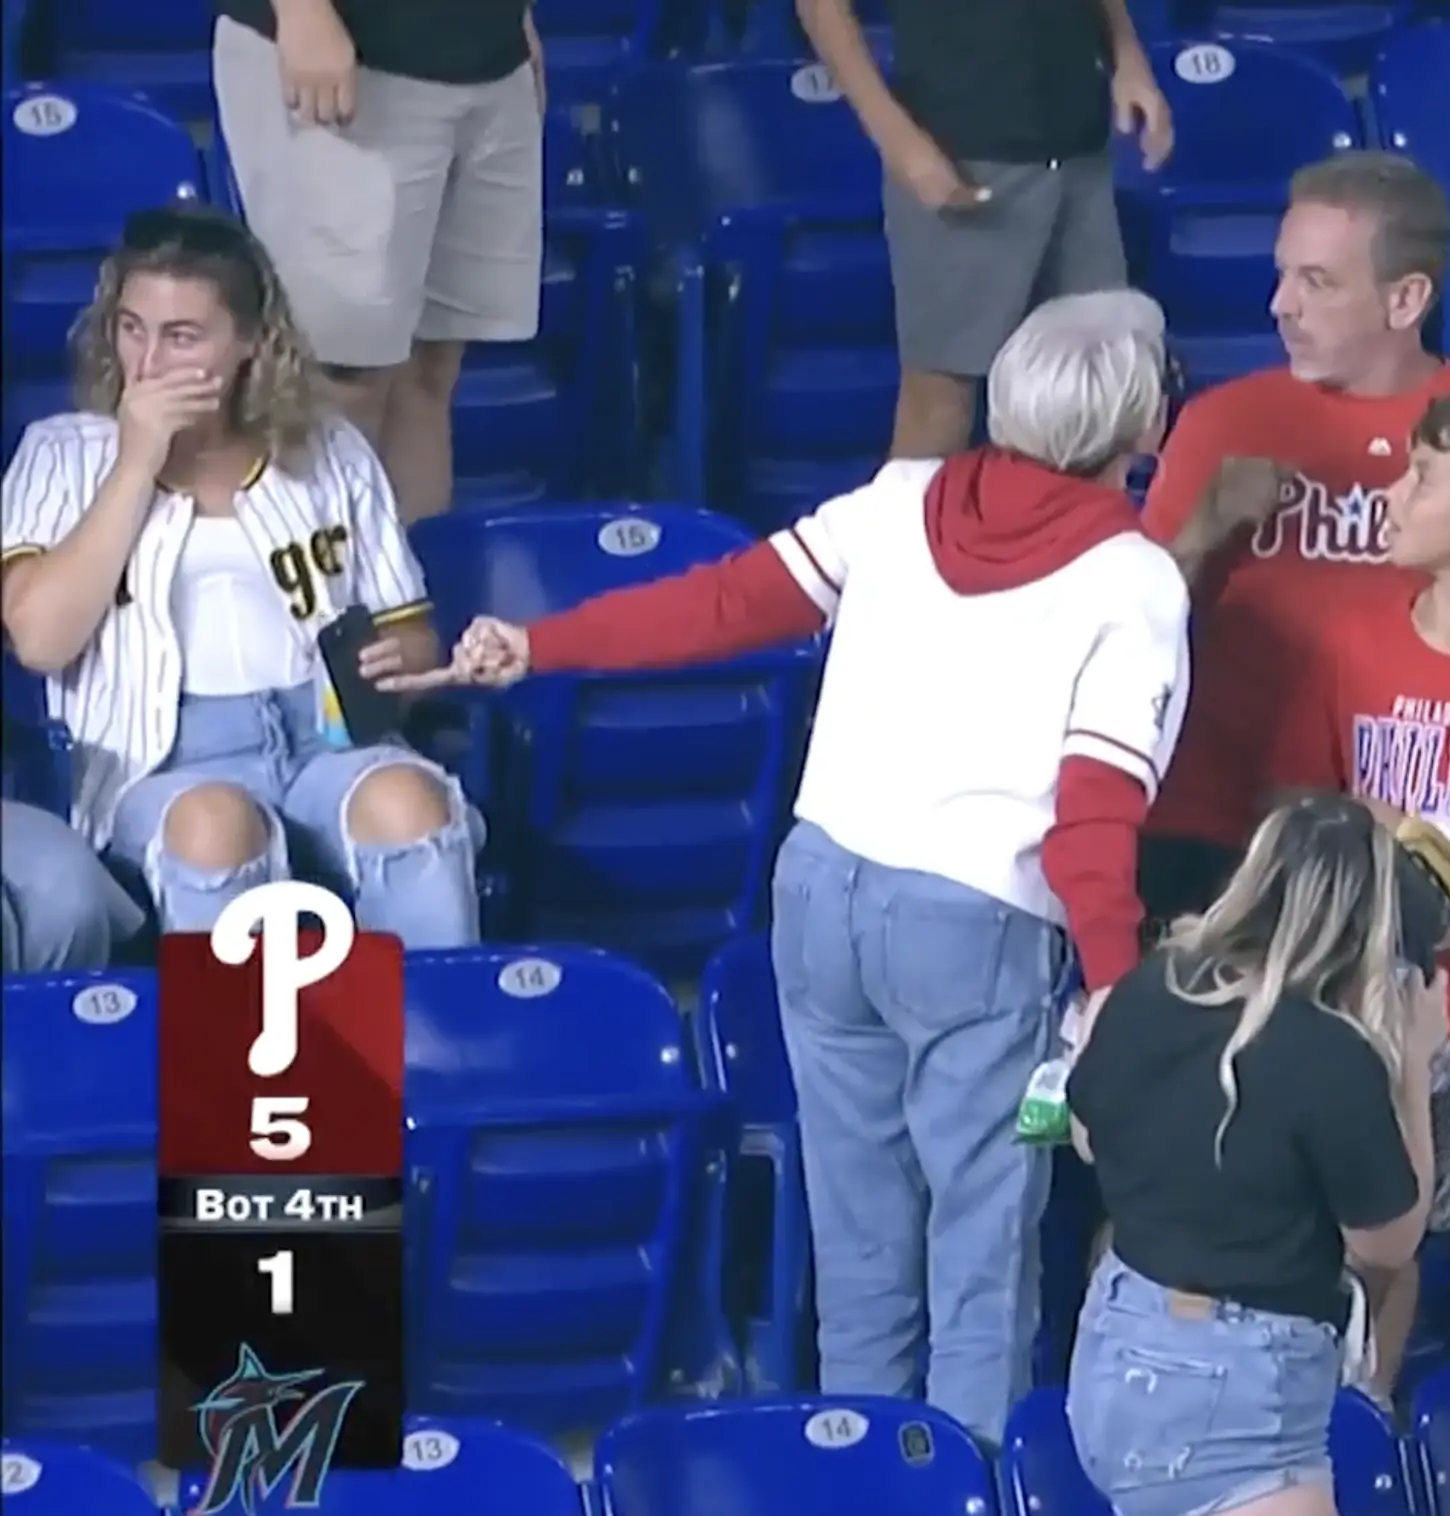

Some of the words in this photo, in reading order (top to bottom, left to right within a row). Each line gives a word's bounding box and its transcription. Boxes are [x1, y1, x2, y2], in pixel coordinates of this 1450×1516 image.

[1191, 52, 1220, 76] 18
[513, 965, 545, 990] 14
[91, 990, 121, 1015] 13
[821, 1416, 853, 1441] 14
[411, 1437, 443, 1462] 13
